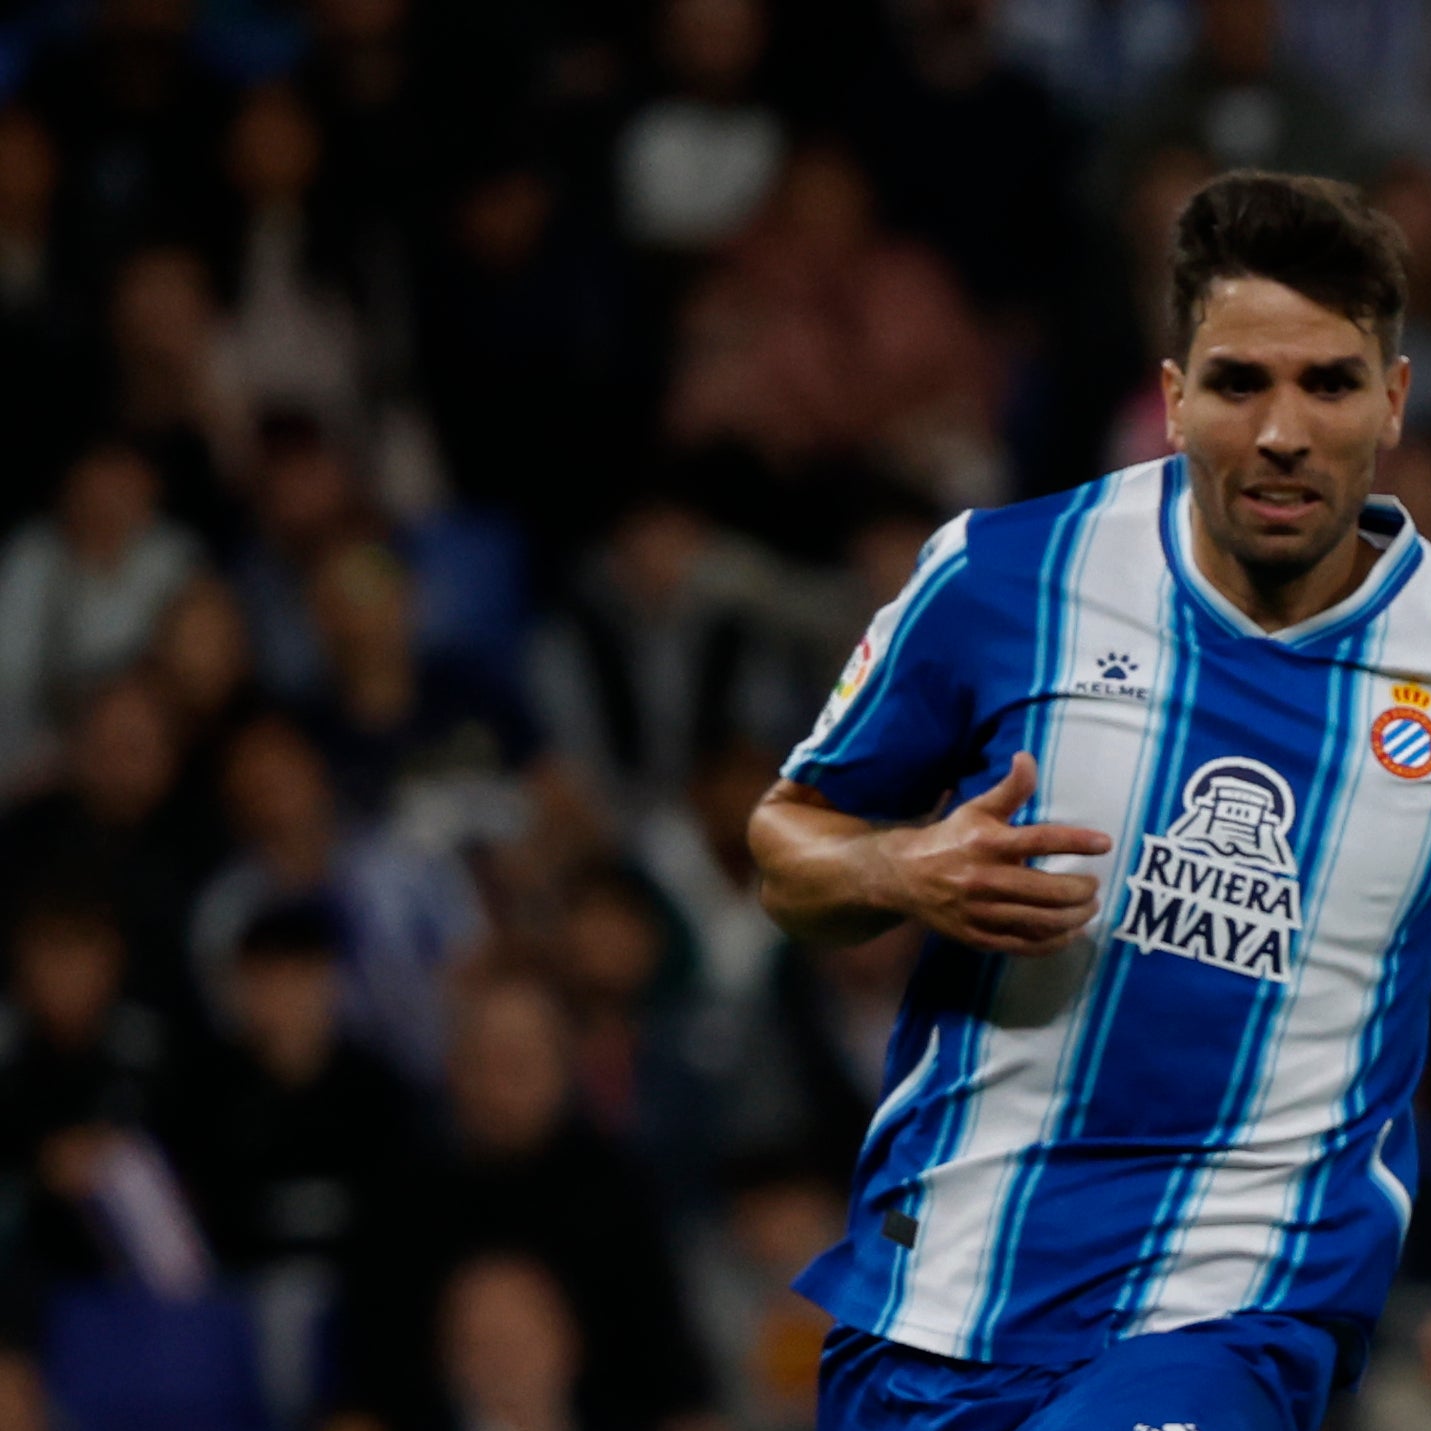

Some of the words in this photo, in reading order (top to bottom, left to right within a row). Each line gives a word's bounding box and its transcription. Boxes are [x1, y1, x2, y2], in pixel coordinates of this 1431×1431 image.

[1076, 682, 1148, 700] KELME
[1144, 846, 1293, 920] RIVIERA
[1125, 886, 1282, 974] MAYA
